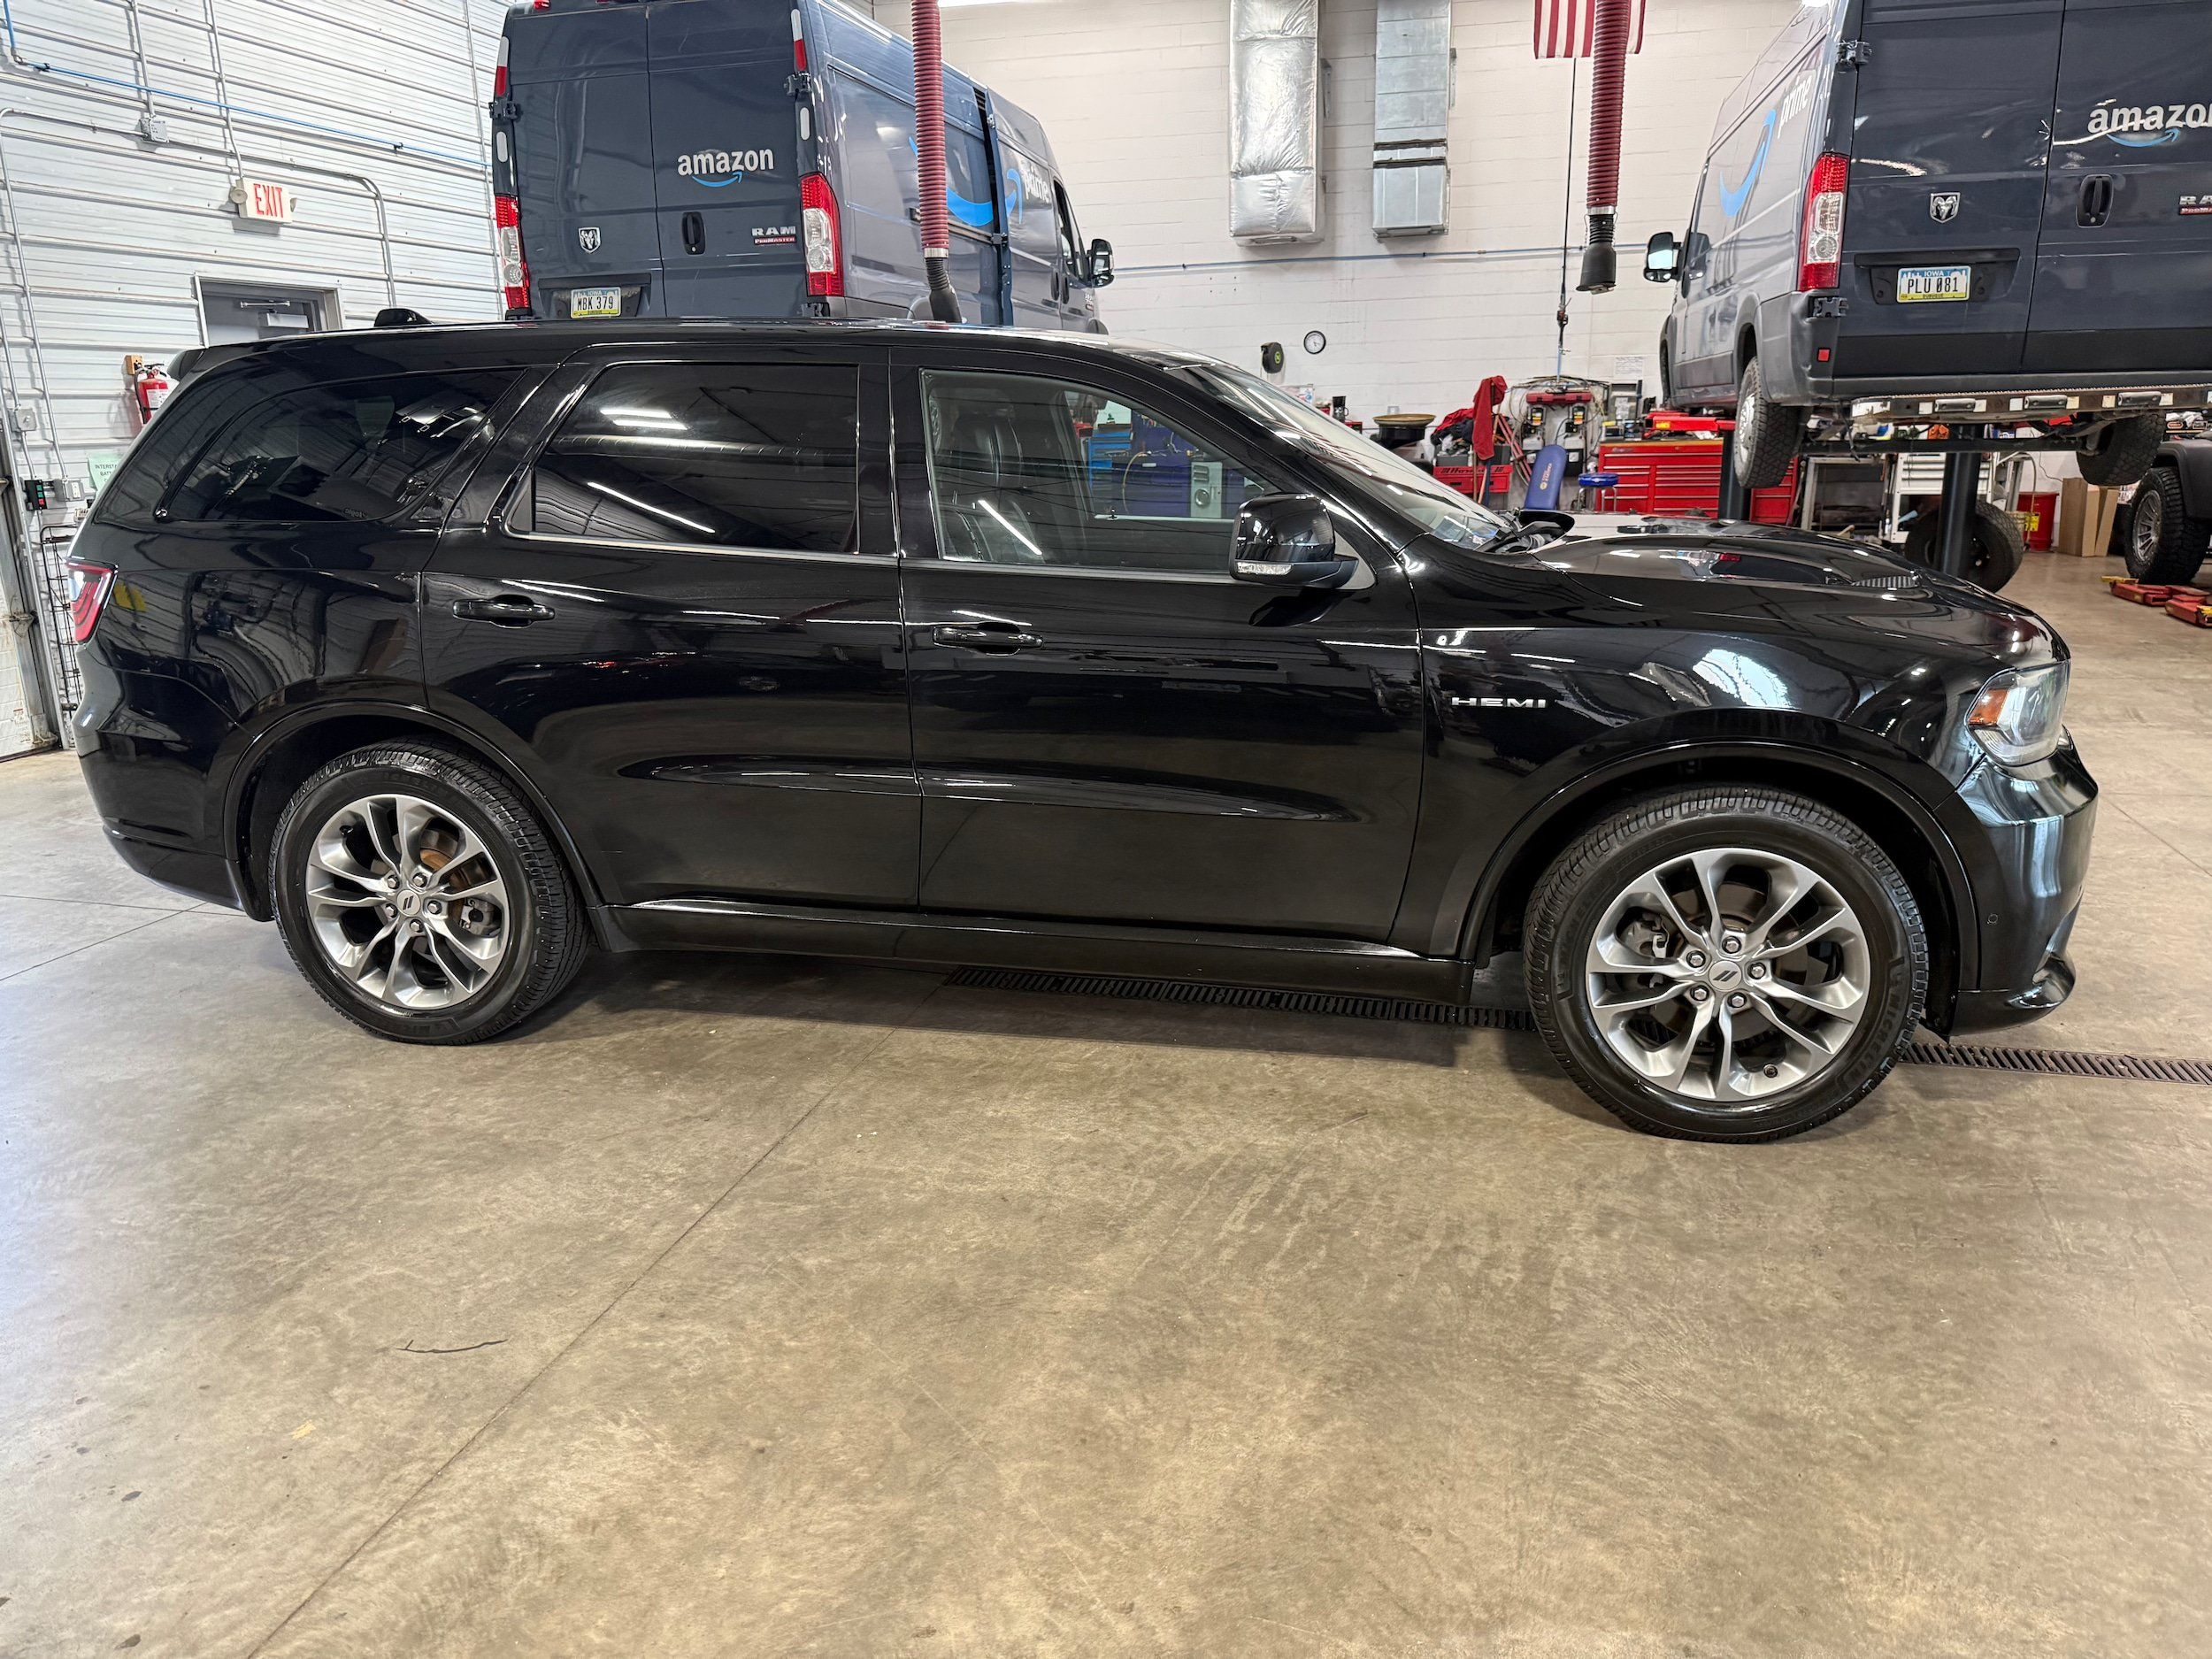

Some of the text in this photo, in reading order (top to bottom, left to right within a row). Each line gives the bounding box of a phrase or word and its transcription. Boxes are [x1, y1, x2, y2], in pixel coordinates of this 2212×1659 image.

[1777, 75, 1812, 139] prime
[677, 149, 774, 176] amazon
[253, 183, 284, 218] EXIT
[2179, 195, 2212, 205] RA
[751, 226, 796, 236] RAM
[1908, 277, 1932, 295] PLU
[577, 296, 613, 311] MBK 379
[1452, 697, 1547, 709] HEMI
